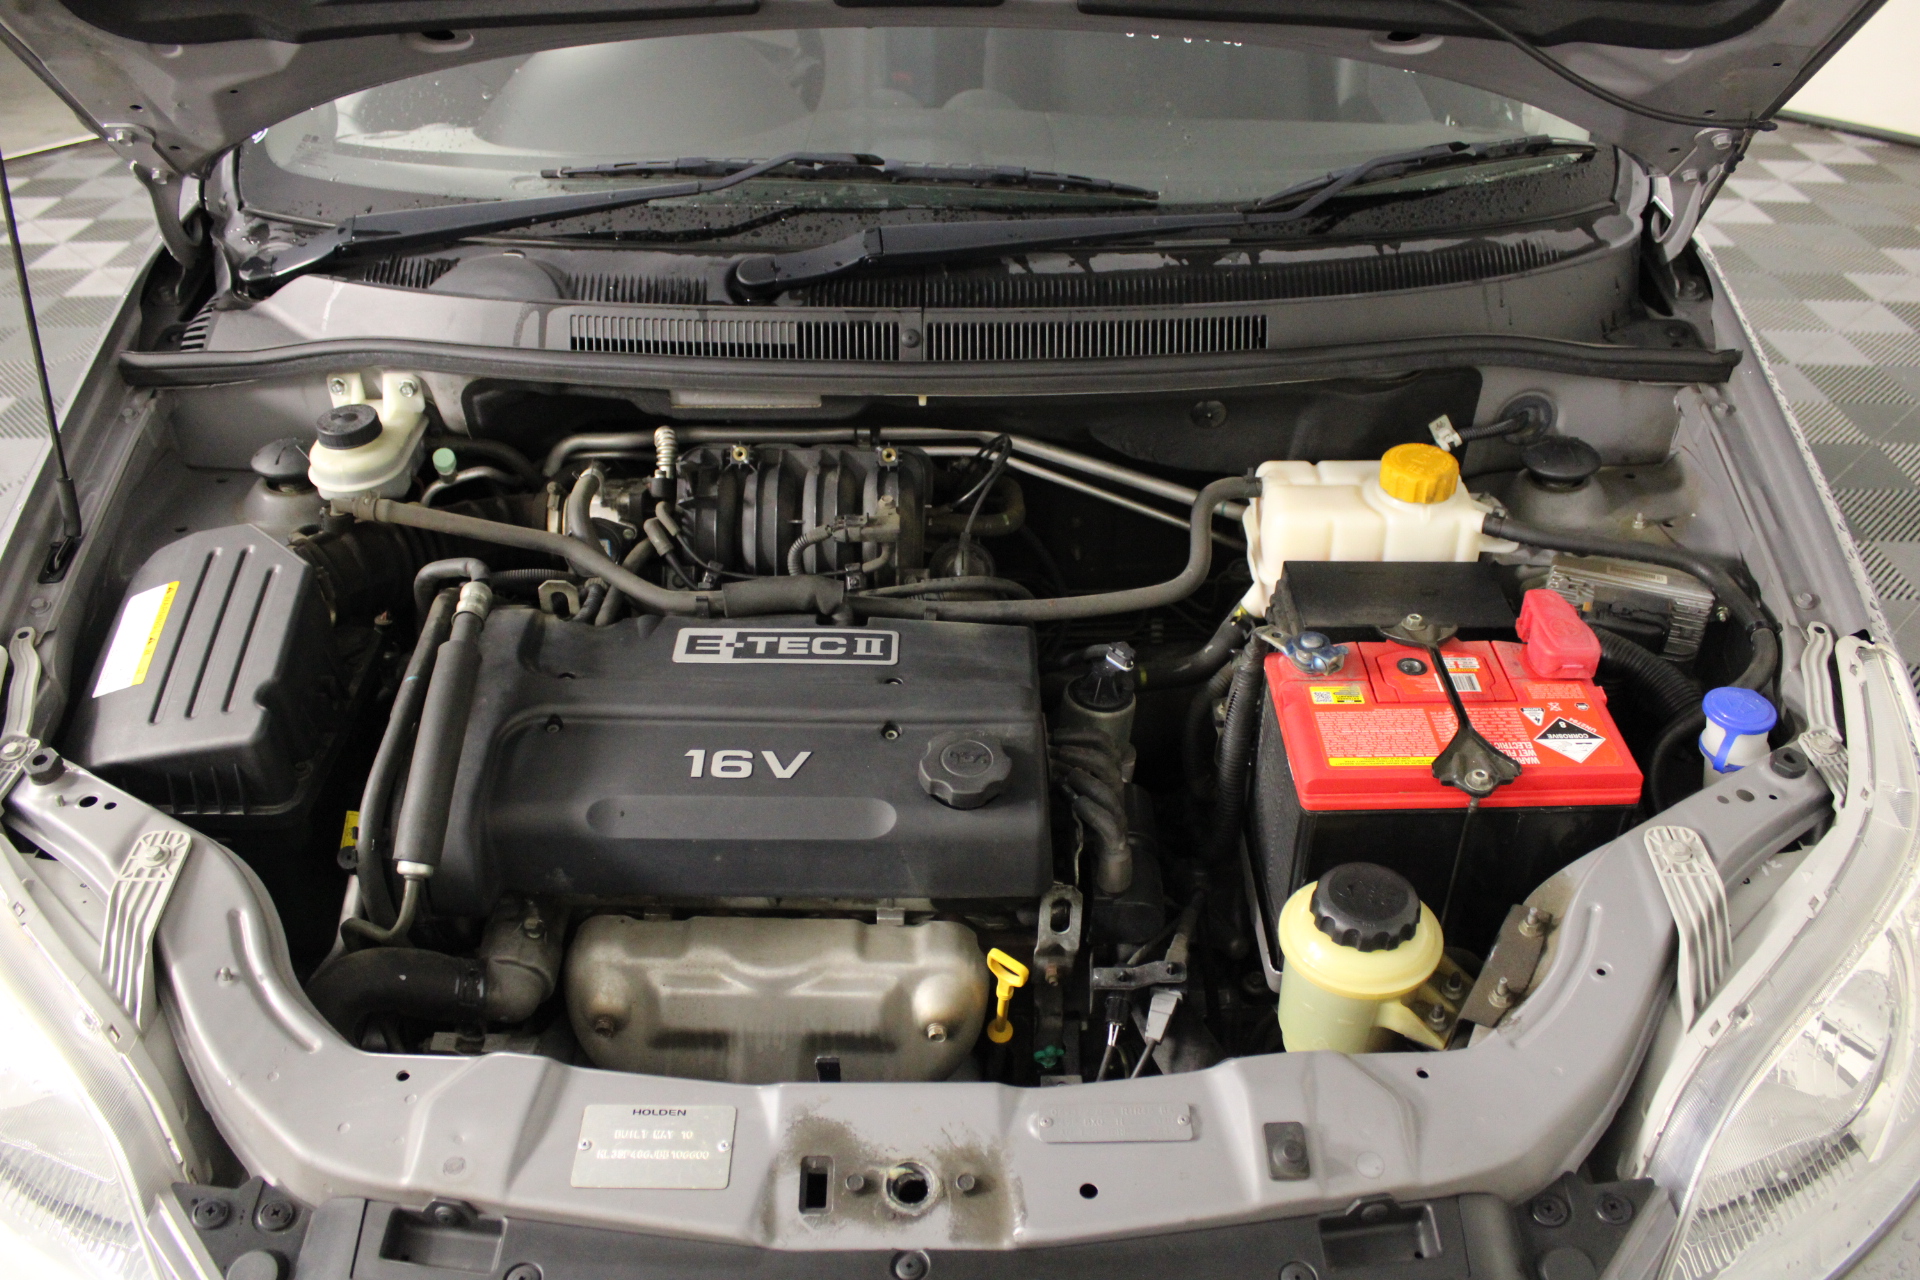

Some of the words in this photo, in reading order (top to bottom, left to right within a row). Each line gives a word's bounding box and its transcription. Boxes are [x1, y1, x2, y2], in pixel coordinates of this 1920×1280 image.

[684, 635, 847, 655] E-TEC
[1558, 720, 1567, 729] 8
[1493, 741, 1534, 749] ELECTRIC
[1518, 749, 1537, 757] WET
[632, 1109, 687, 1117] HOLDEN
[614, 1129, 648, 1139] BUILT
[681, 1130, 694, 1139] 10
